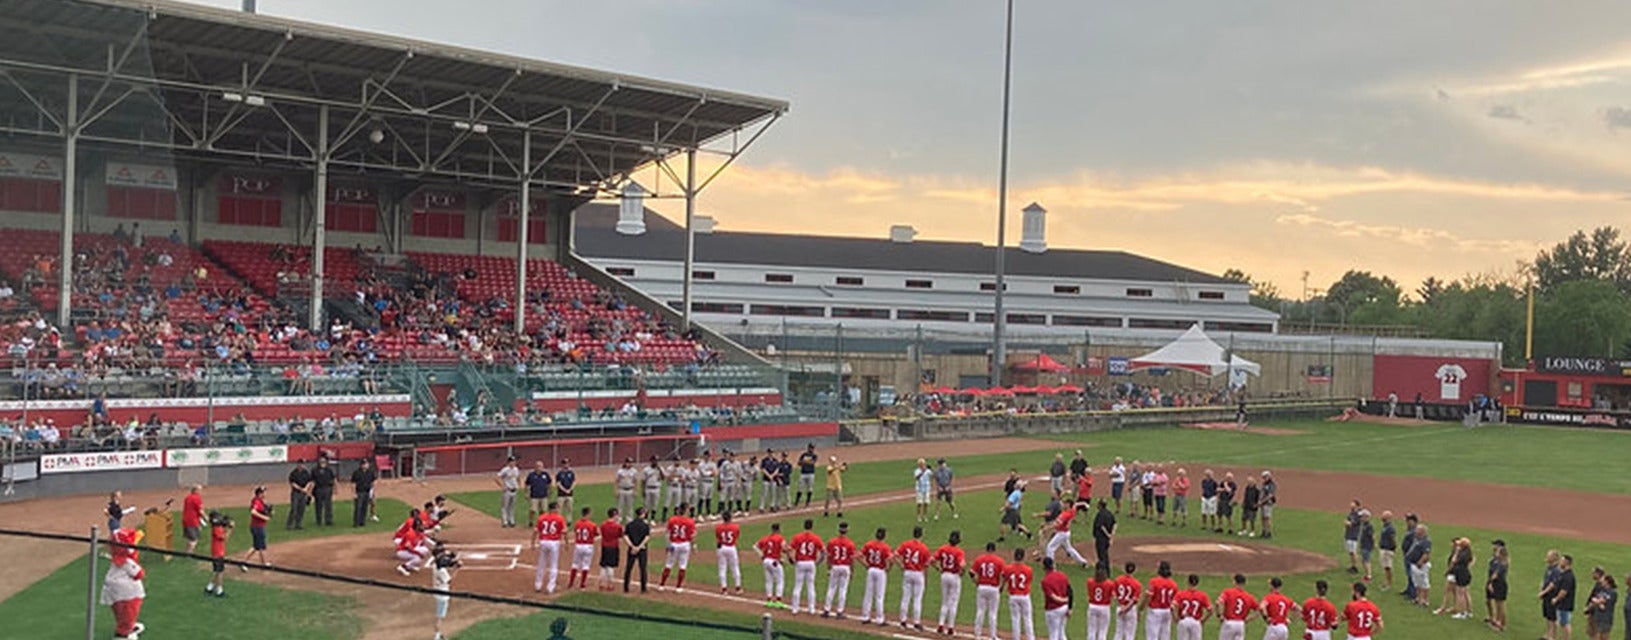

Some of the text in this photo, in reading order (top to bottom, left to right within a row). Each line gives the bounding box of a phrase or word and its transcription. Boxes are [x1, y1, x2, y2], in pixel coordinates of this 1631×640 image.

[1545, 357, 1606, 371] LOUNGE
[1444, 373, 1458, 384] 22
[542, 520, 557, 535] 26
[576, 528, 589, 541] 10
[672, 524, 687, 540] 36
[721, 531, 734, 544] 15
[800, 541, 815, 556] 49
[833, 545, 847, 560] 33
[904, 547, 920, 565] 34
[981, 562, 995, 578] 18
[1009, 573, 1027, 590] 12
[1095, 587, 1103, 602] 8
[1117, 583, 1133, 601] 92
[1235, 598, 1244, 615] 3
[1278, 601, 1286, 617] 7
[1309, 608, 1326, 627] 14
[1357, 611, 1373, 629] 13
